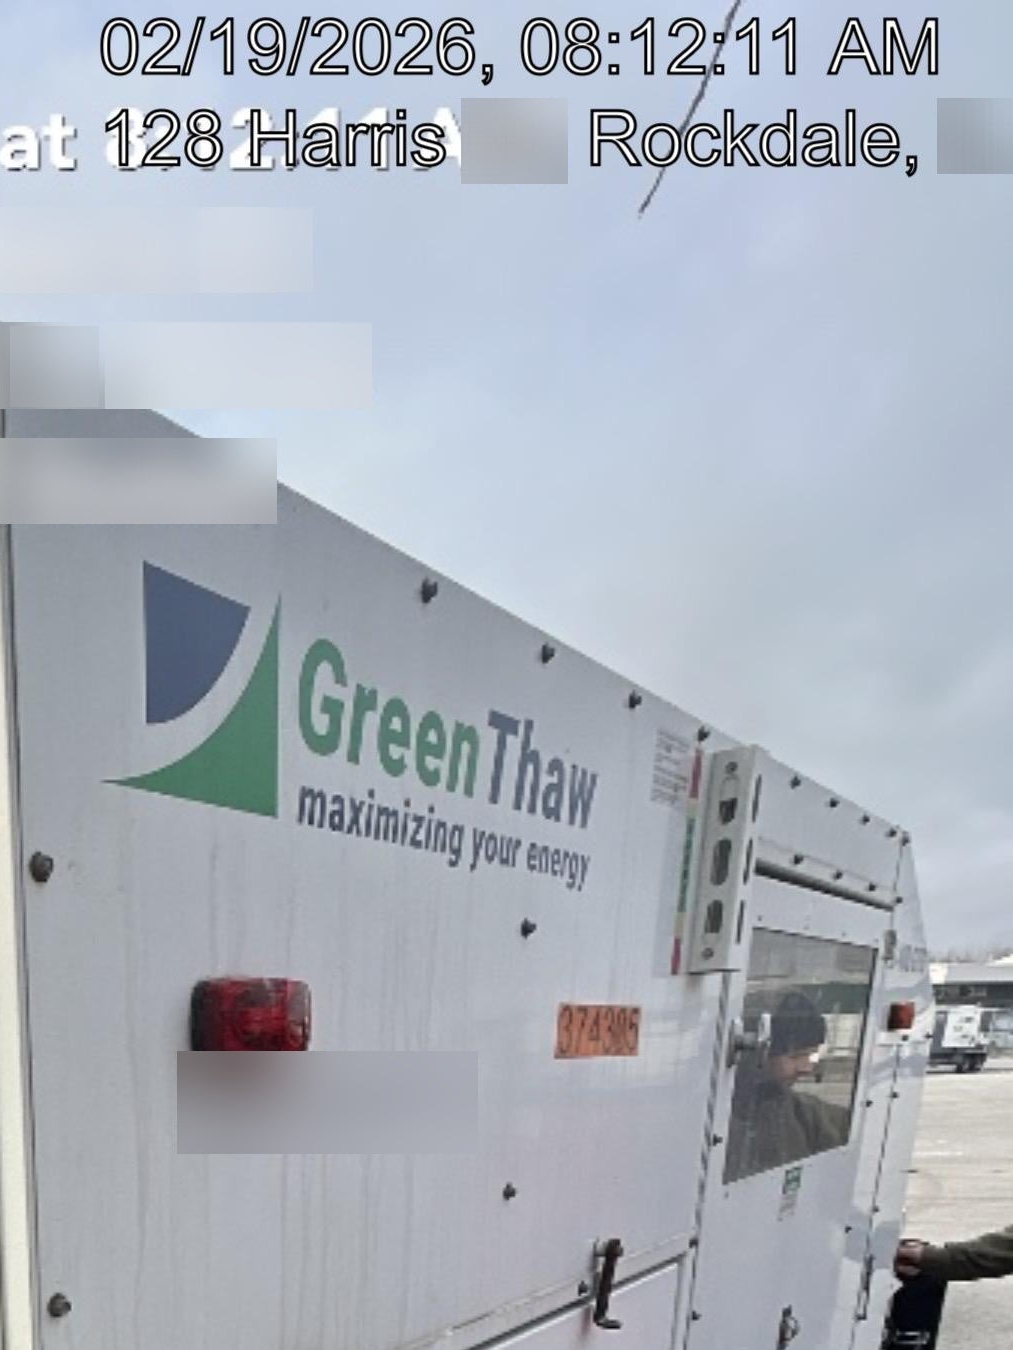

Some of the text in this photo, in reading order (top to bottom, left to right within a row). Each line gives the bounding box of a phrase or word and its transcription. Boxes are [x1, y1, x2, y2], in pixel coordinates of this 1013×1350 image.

[297, 785, 590, 892] maximizing your energy
